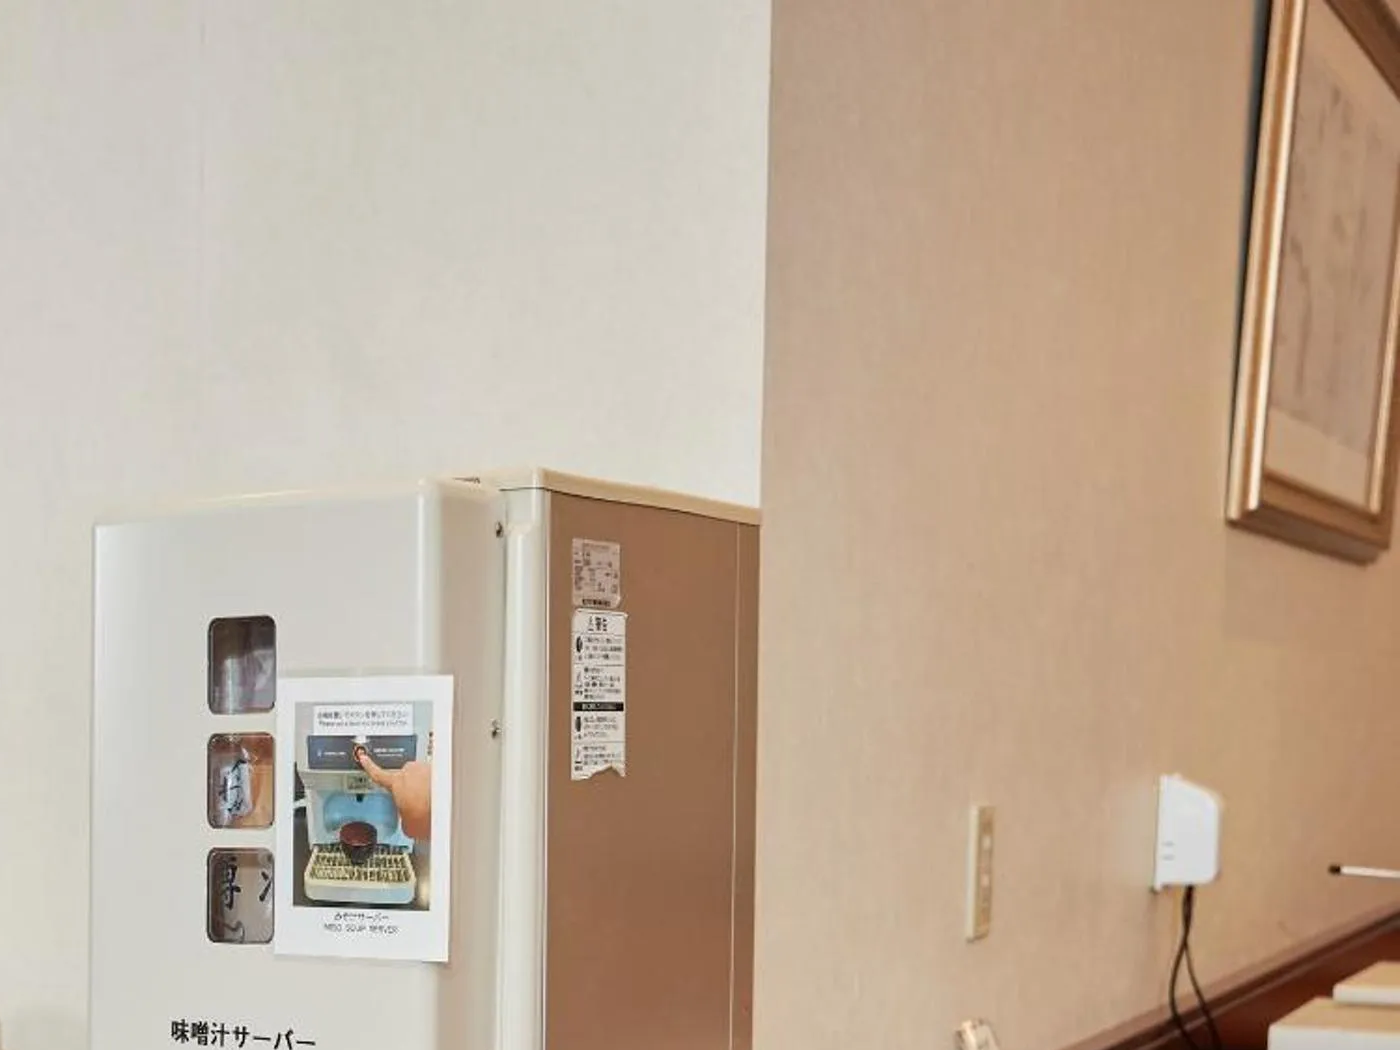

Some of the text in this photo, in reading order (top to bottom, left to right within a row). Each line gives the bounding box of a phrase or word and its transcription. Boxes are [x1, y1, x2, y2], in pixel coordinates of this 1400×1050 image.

[171, 1019, 317, 1050] 味噌汁サーバー
